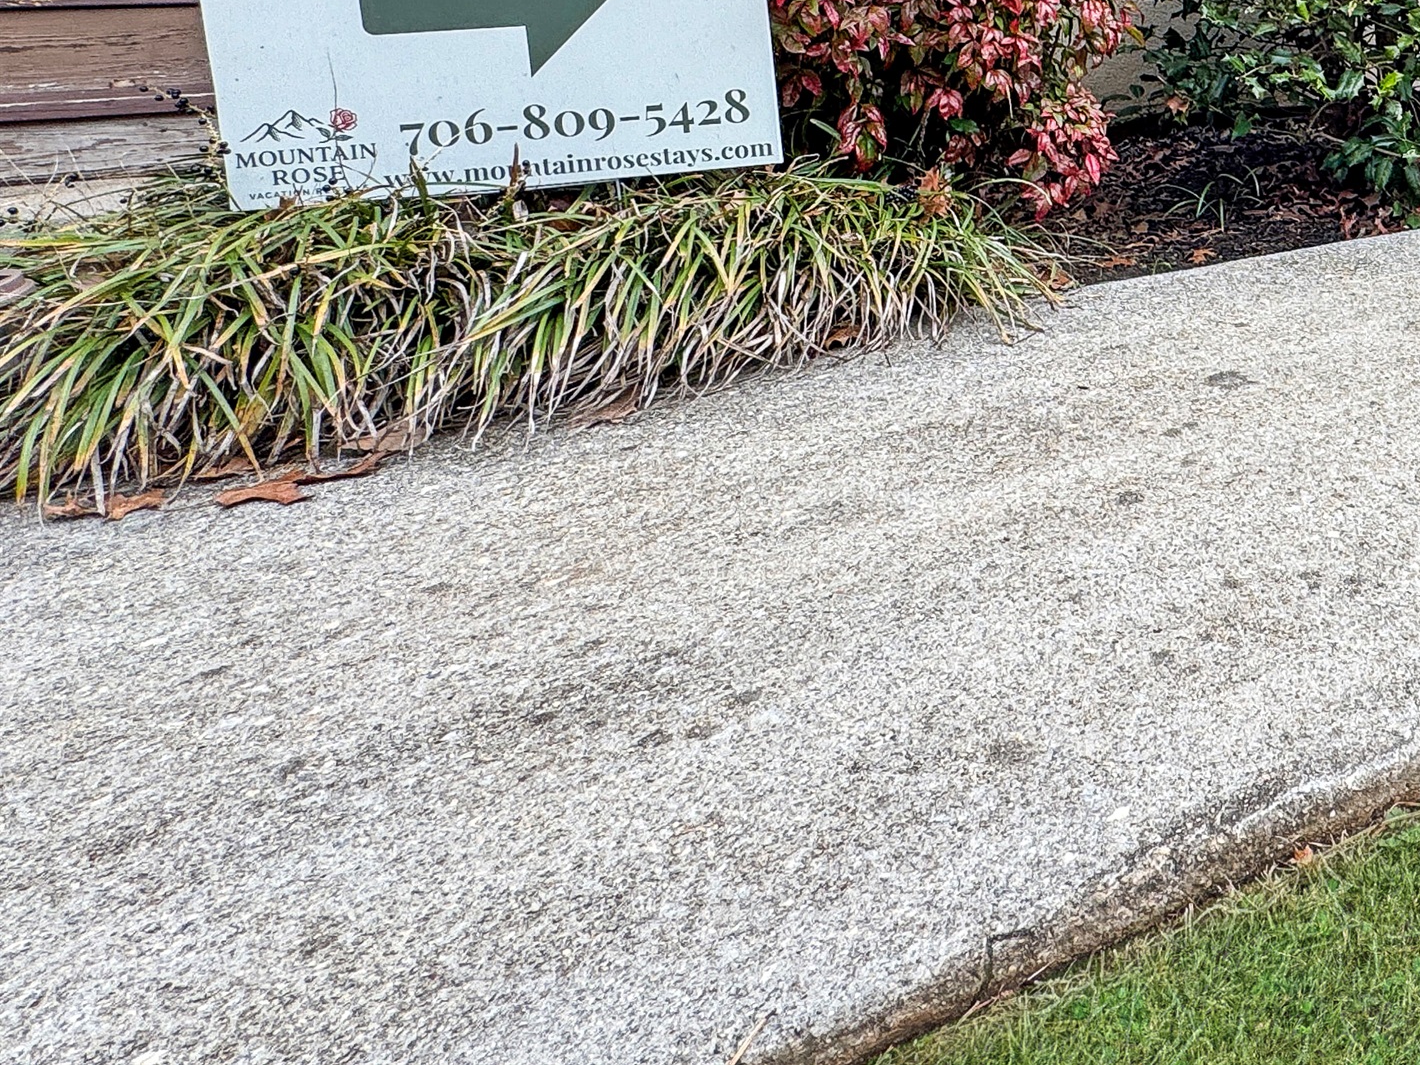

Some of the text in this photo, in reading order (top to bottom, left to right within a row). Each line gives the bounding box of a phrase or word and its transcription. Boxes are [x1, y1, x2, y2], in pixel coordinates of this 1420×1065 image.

[399, 88, 752, 158] 706-809-5428
[235, 142, 377, 169] MOUNTAIN
[383, 141, 774, 189] ww.montainrosestays.com
[271, 165, 347, 186] ROSE
